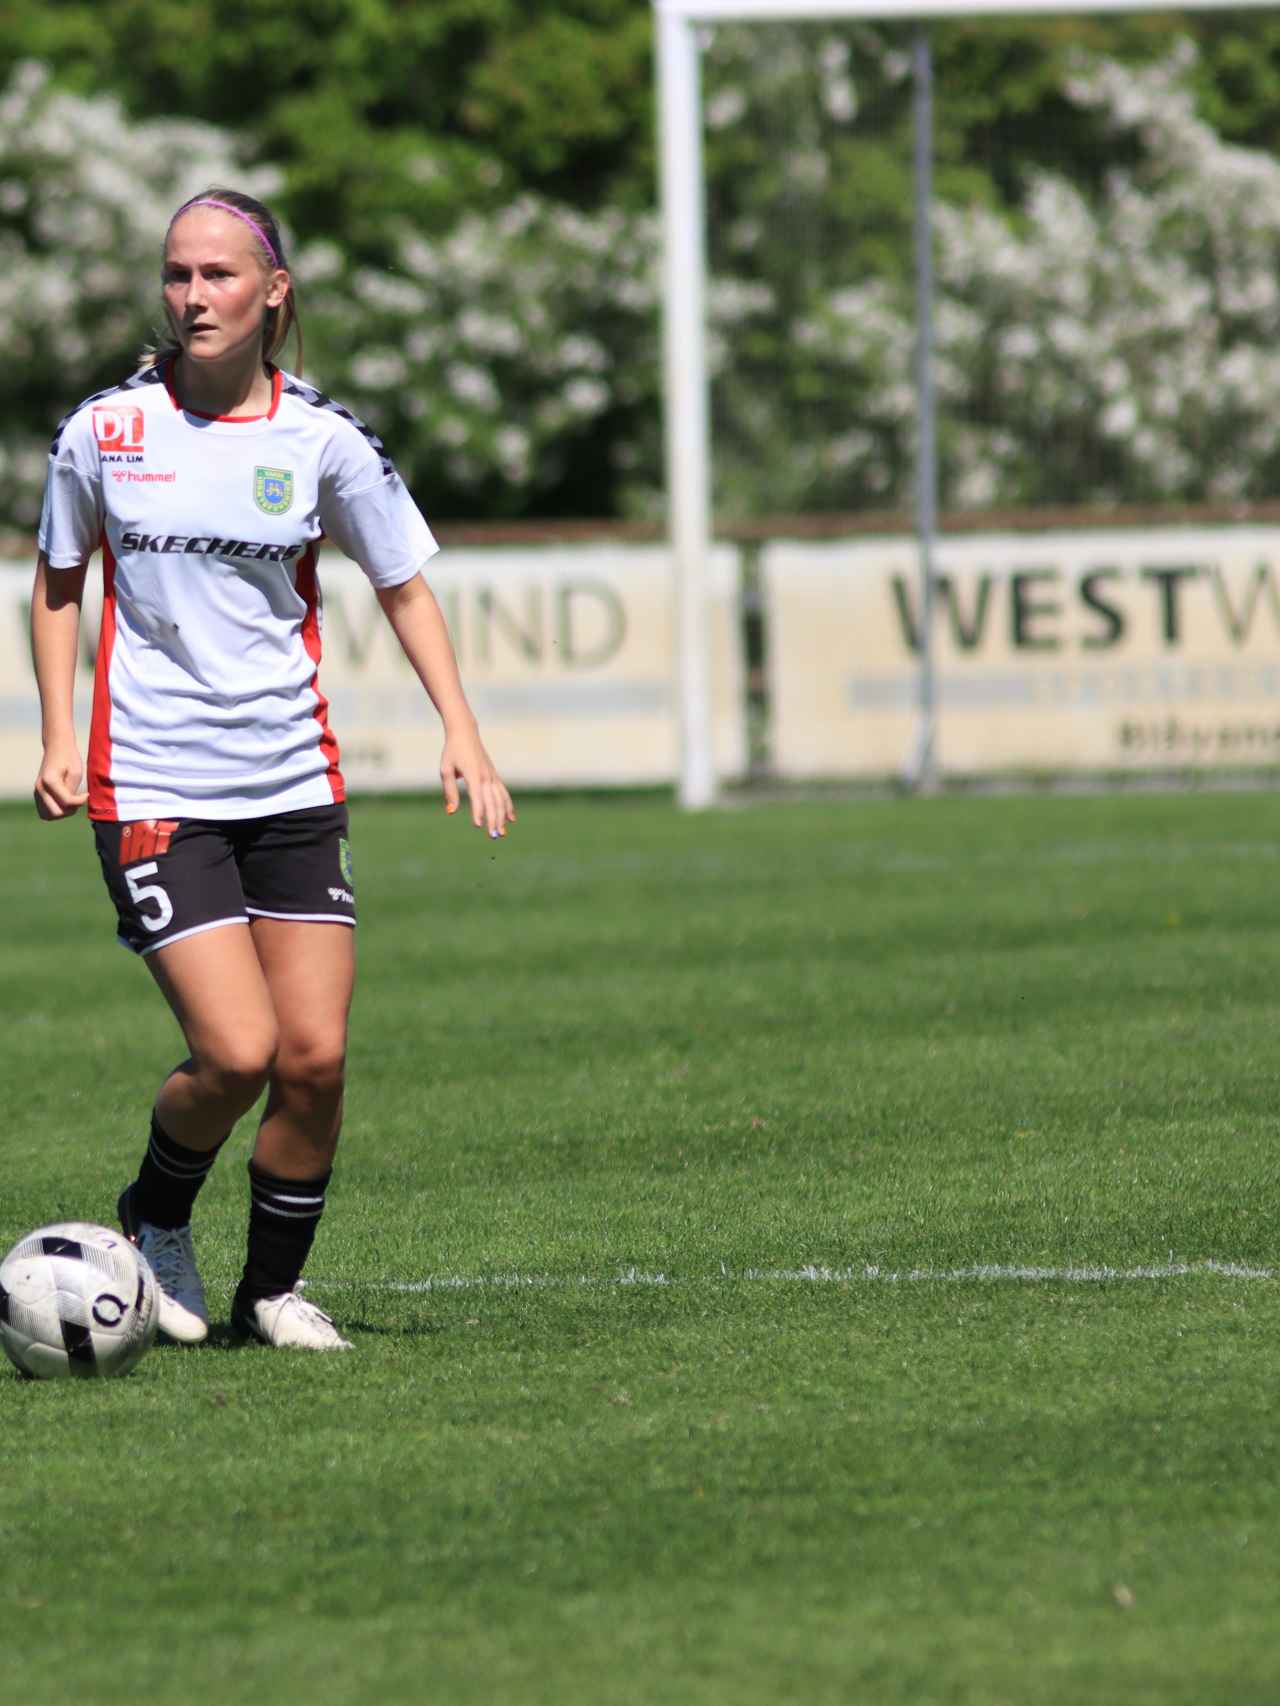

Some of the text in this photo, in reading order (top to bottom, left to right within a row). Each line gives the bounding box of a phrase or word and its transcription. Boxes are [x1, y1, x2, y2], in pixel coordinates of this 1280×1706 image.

[100, 455, 144, 463] ANA LIM
[128, 470, 176, 482] hummel
[124, 861, 174, 932] 5
